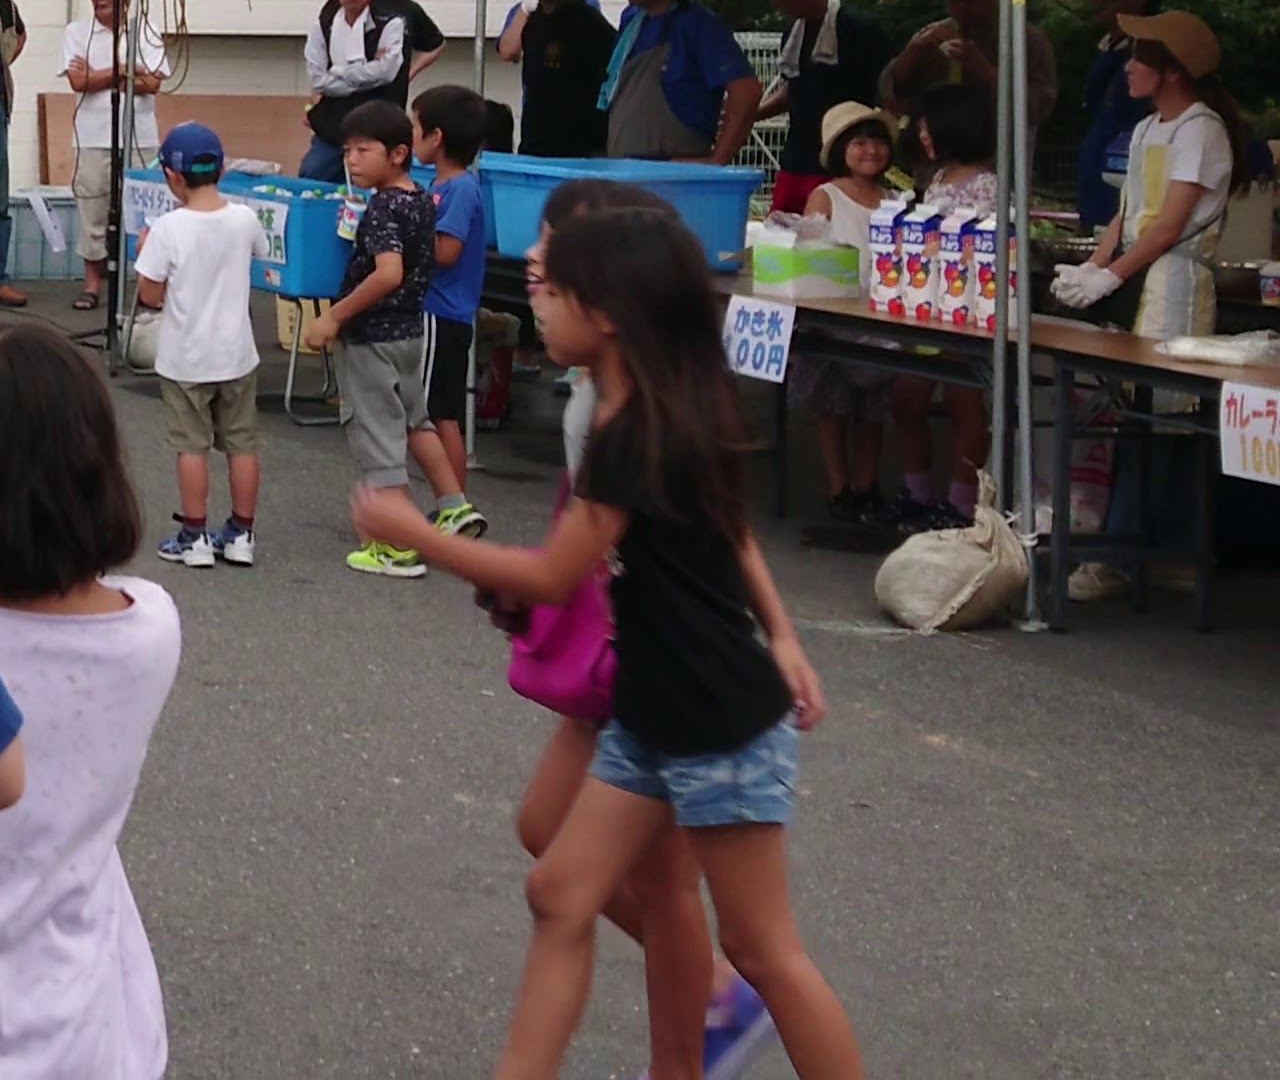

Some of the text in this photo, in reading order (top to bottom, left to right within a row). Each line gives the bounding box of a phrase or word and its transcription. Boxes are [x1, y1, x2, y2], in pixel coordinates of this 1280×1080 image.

[735, 306, 783, 341] かき氷
[1225, 392, 1280, 436] カレーラ
